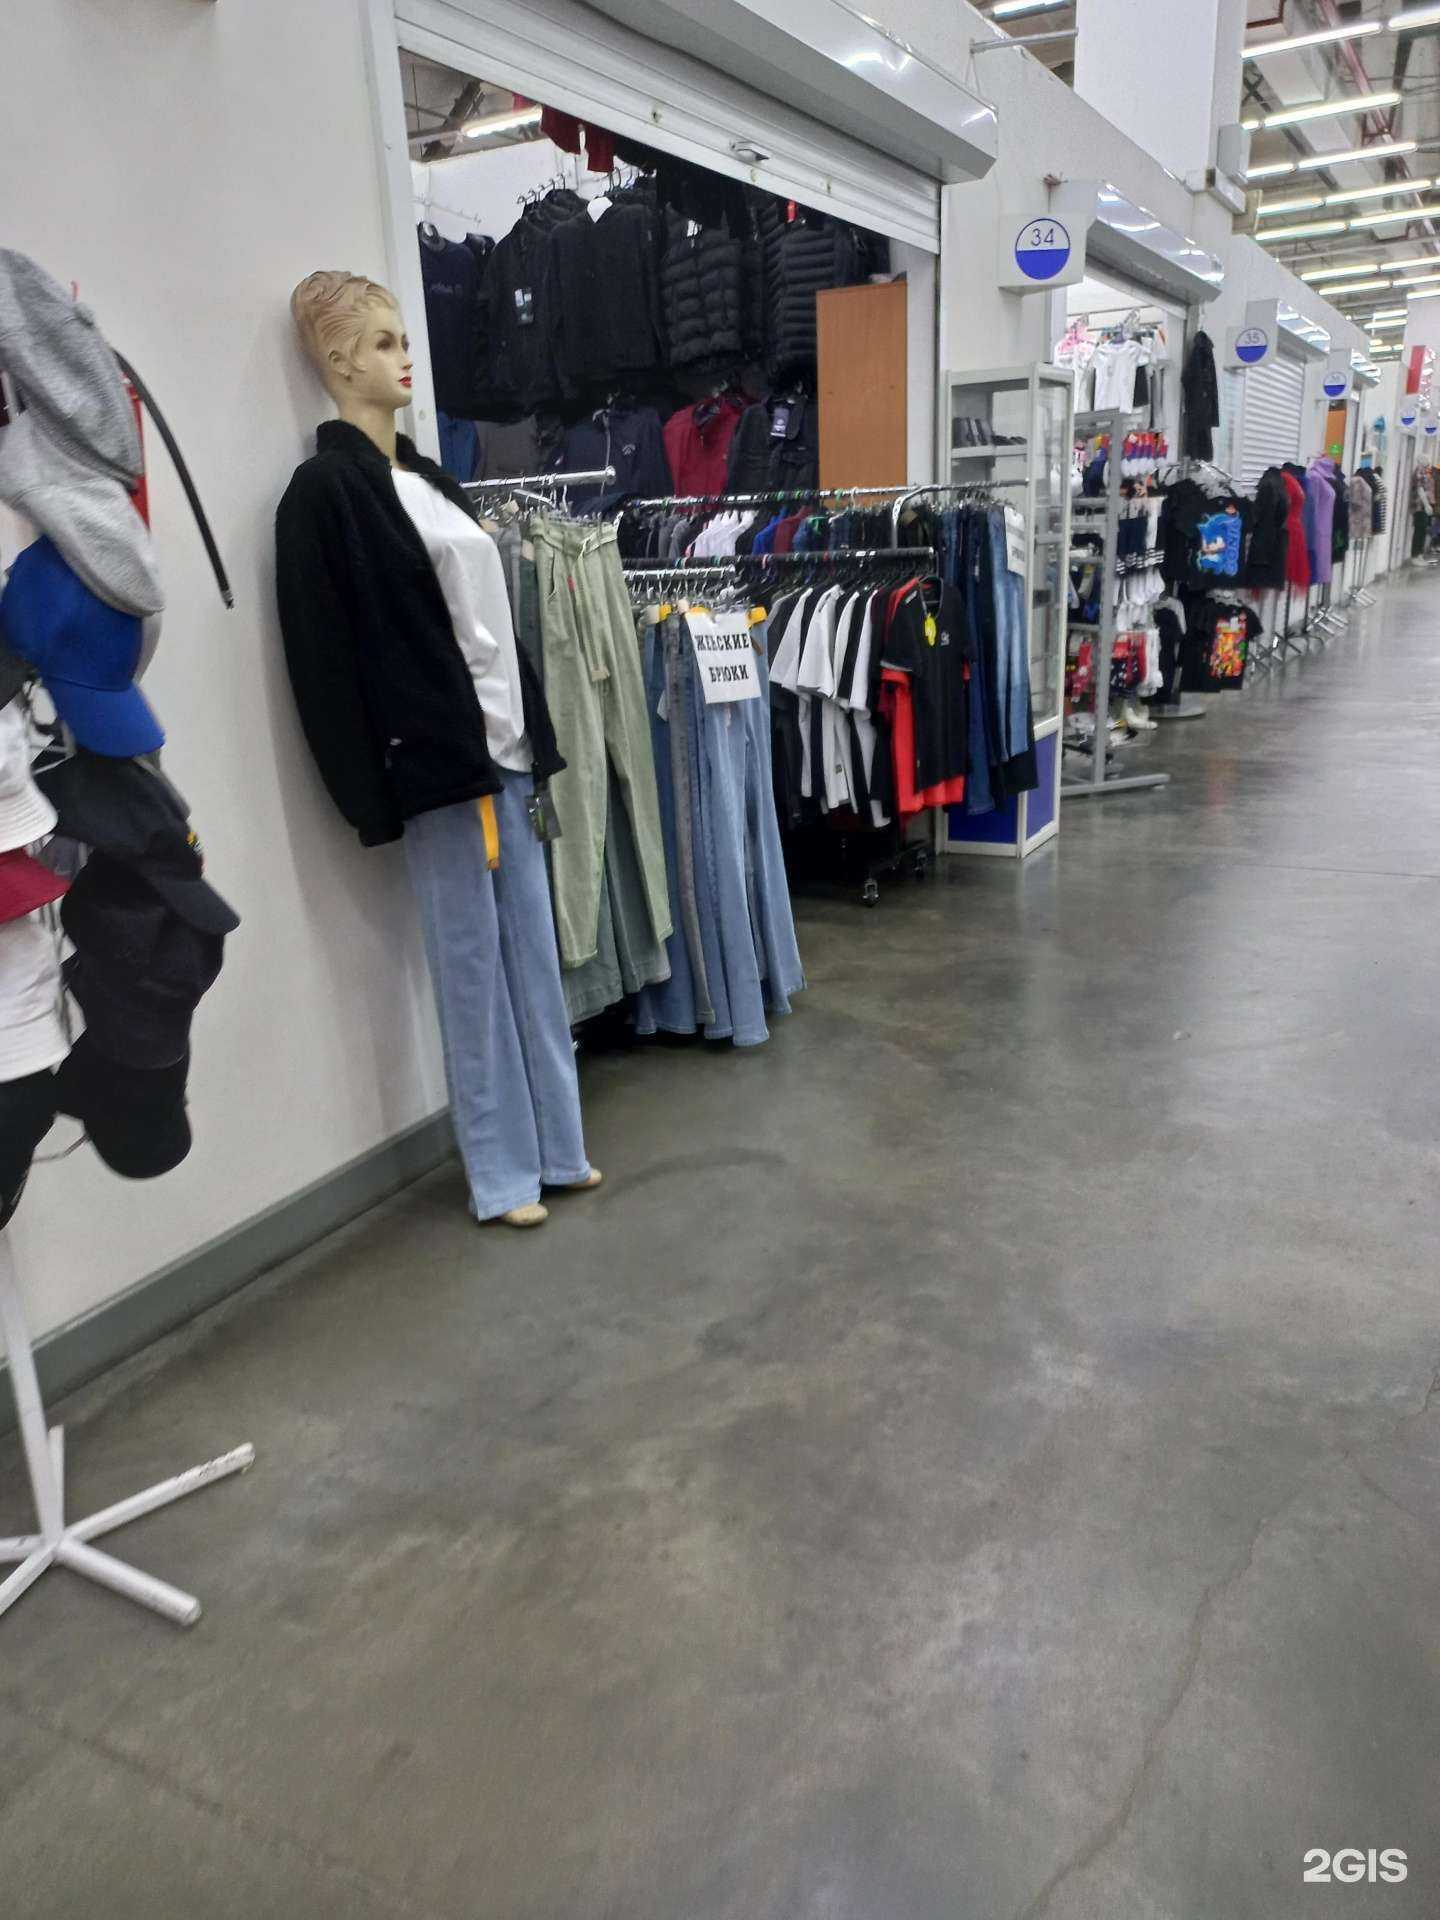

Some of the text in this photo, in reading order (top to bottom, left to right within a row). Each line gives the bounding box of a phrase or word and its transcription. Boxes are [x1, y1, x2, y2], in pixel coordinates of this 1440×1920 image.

[1031, 228, 1054, 246] 34
[694, 633, 750, 651] ЖЕНСКИЕ
[708, 664, 749, 682] БРЮКИ
